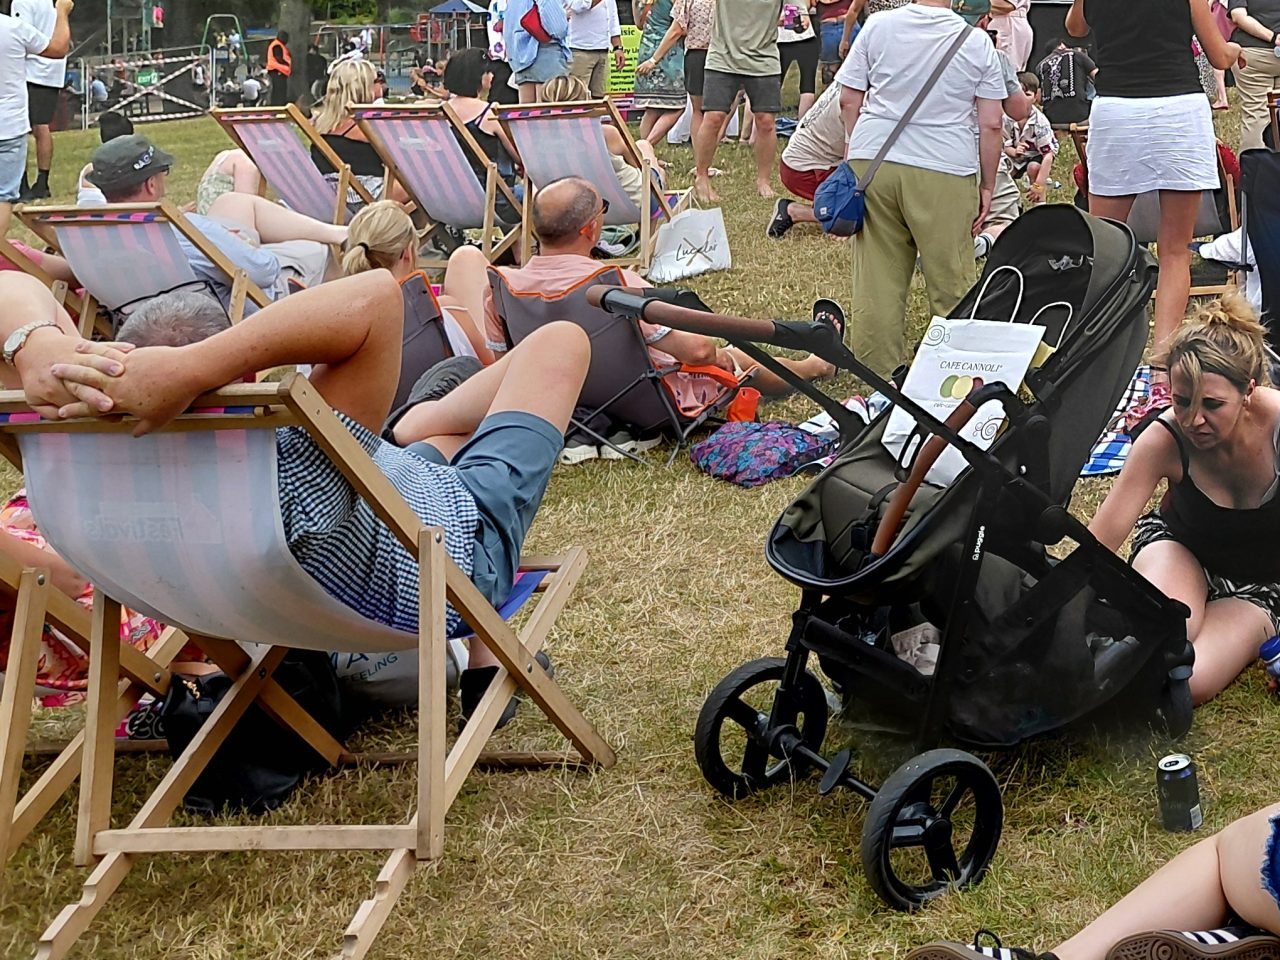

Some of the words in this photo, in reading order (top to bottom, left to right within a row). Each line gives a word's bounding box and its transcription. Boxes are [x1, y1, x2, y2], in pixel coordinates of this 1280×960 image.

[939, 360, 962, 371] CAFE
[961, 361, 1000, 372] CANNOLI
[974, 525, 985, 553] puggle
